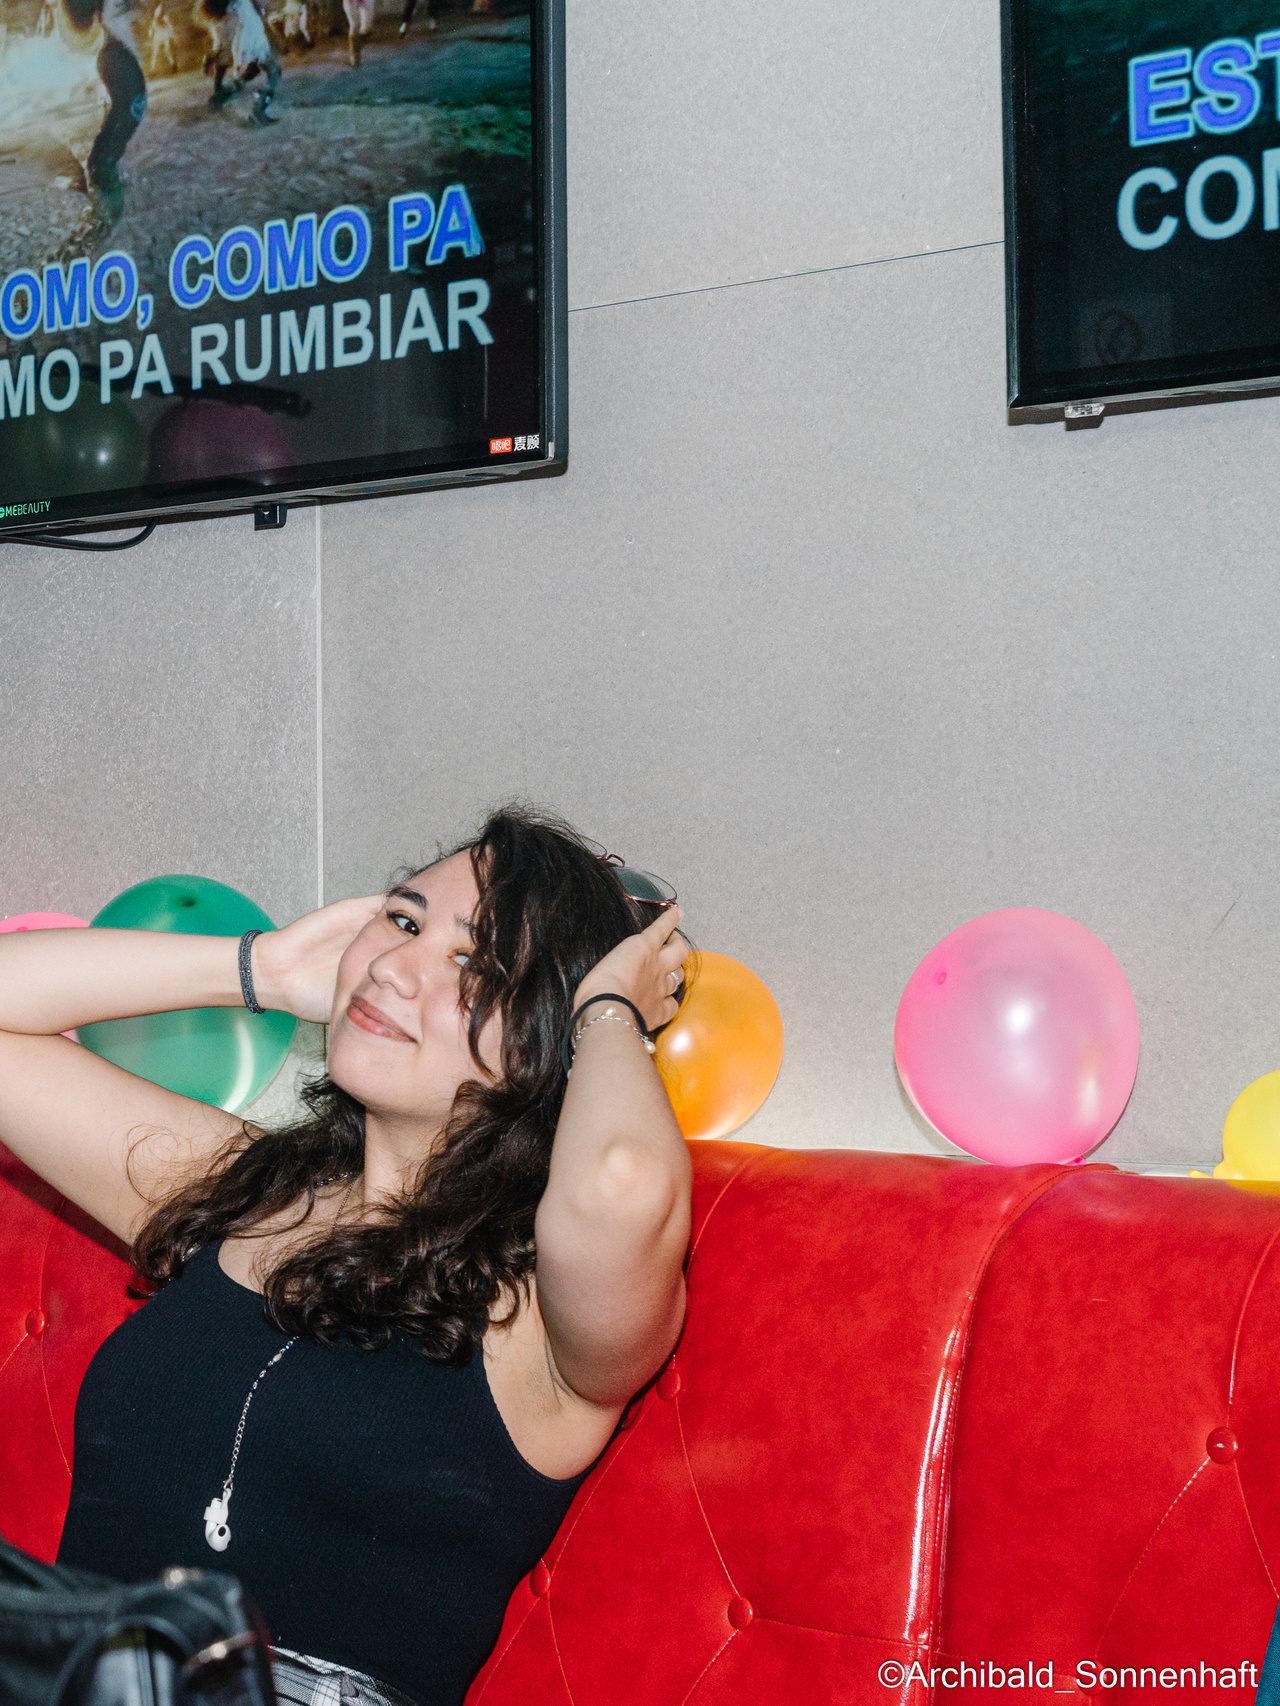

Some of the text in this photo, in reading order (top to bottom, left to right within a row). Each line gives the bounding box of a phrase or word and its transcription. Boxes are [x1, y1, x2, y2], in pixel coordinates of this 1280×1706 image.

[169, 204, 371, 310] COMO
[388, 183, 485, 272] PA
[1117, 147, 1280, 251] CO
[99, 333, 174, 405] PA
[191, 278, 494, 390] RUMBIAR
